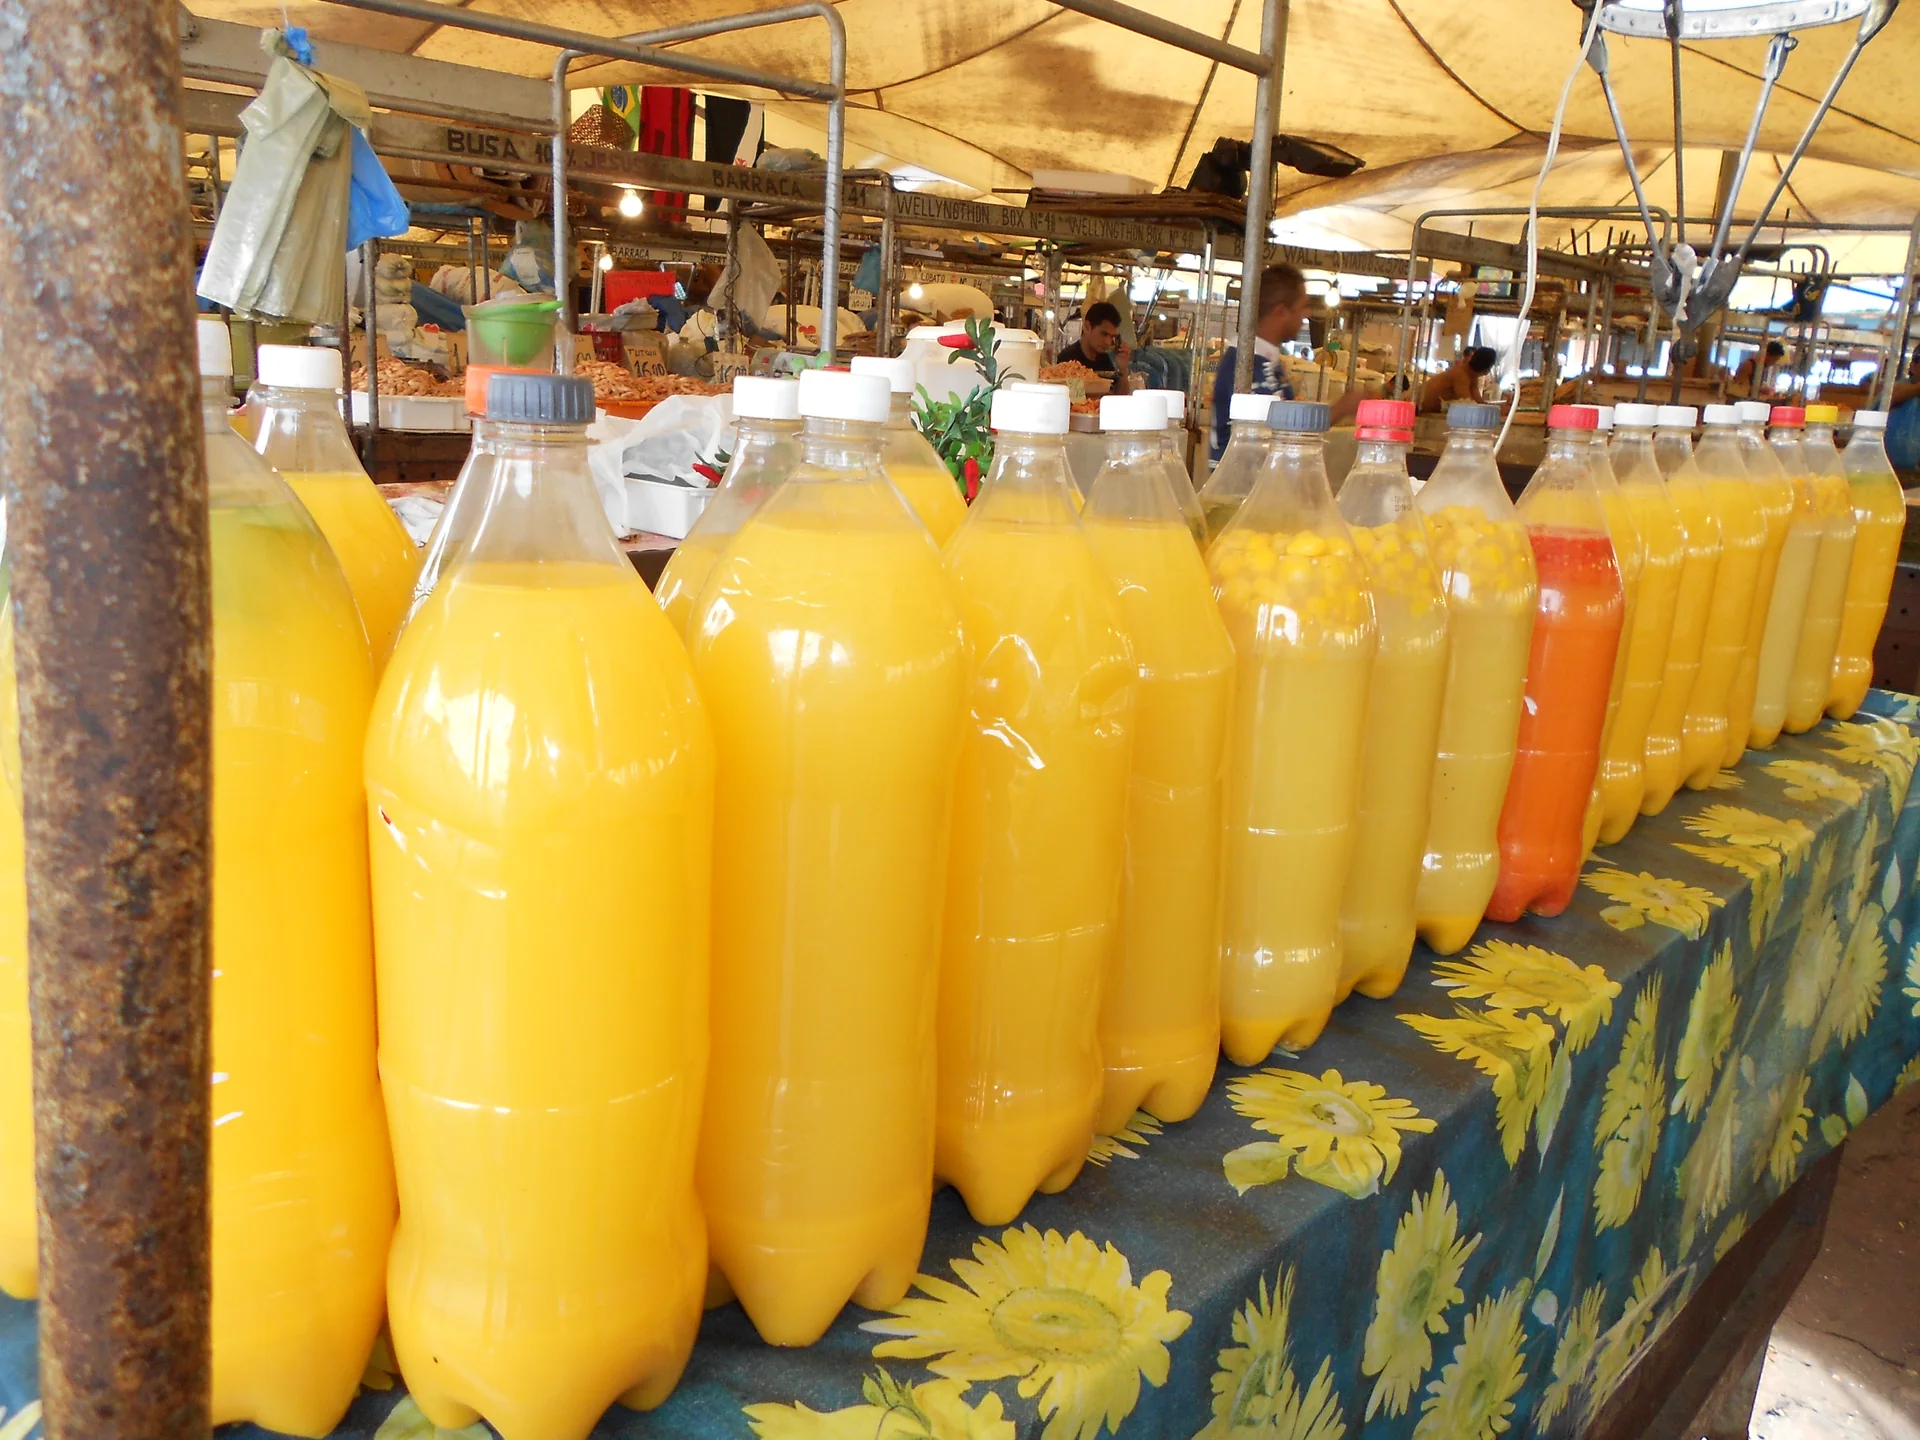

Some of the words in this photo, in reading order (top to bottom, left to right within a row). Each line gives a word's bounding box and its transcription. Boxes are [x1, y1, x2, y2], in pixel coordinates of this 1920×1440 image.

[448, 129, 520, 160] BUSA
[712, 169, 803, 198] BARRACA
[1002, 208, 1025, 227] BOX
[1147, 224, 1163, 245] BOX
[612, 246, 649, 259] BARRACA
[672, 251, 682, 261] DO
[1282, 245, 1323, 266] WALL
[920, 272, 945, 284] LOBATO
